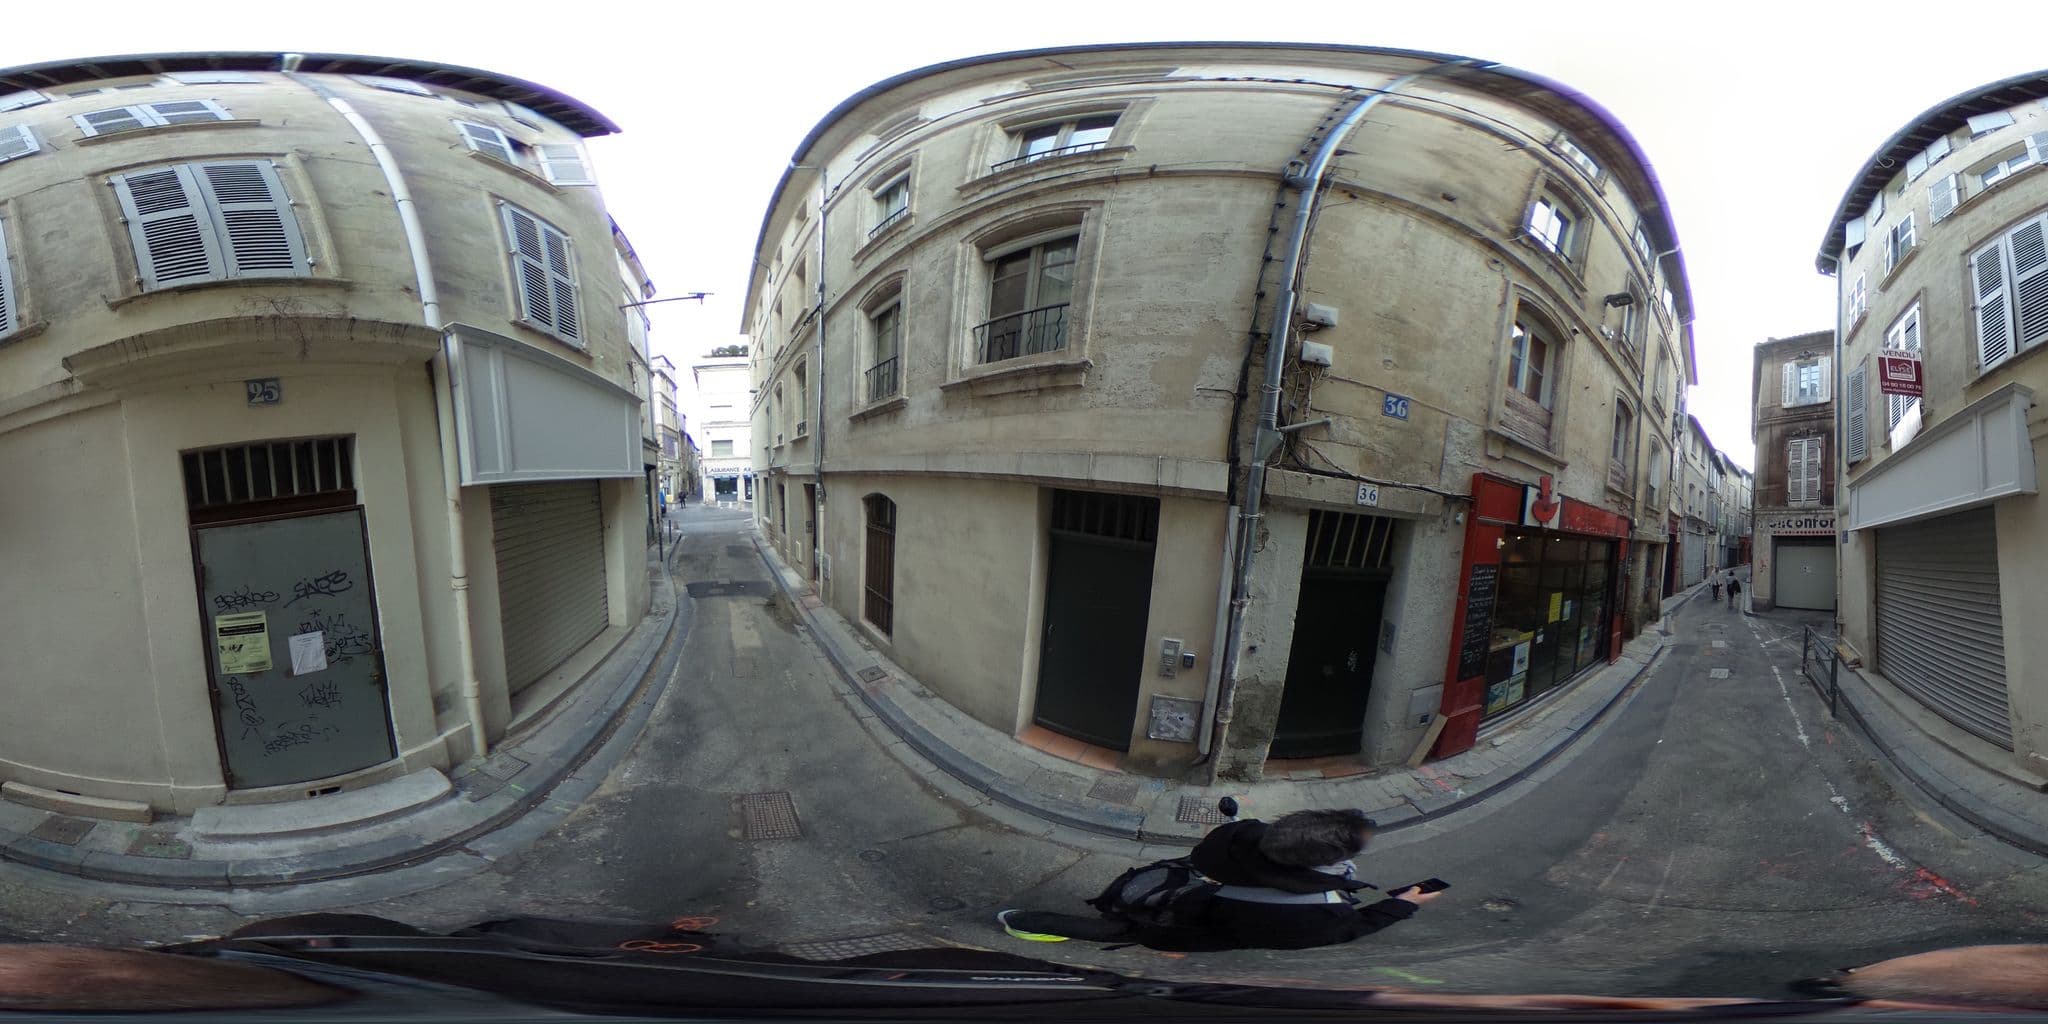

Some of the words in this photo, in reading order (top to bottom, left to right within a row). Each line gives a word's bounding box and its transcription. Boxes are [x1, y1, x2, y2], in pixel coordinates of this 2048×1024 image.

[1882, 350, 1915, 358] VENDU
[248, 381, 280, 403] 25
[1386, 397, 1408, 417] 36
[1360, 488, 1376, 501] 36
